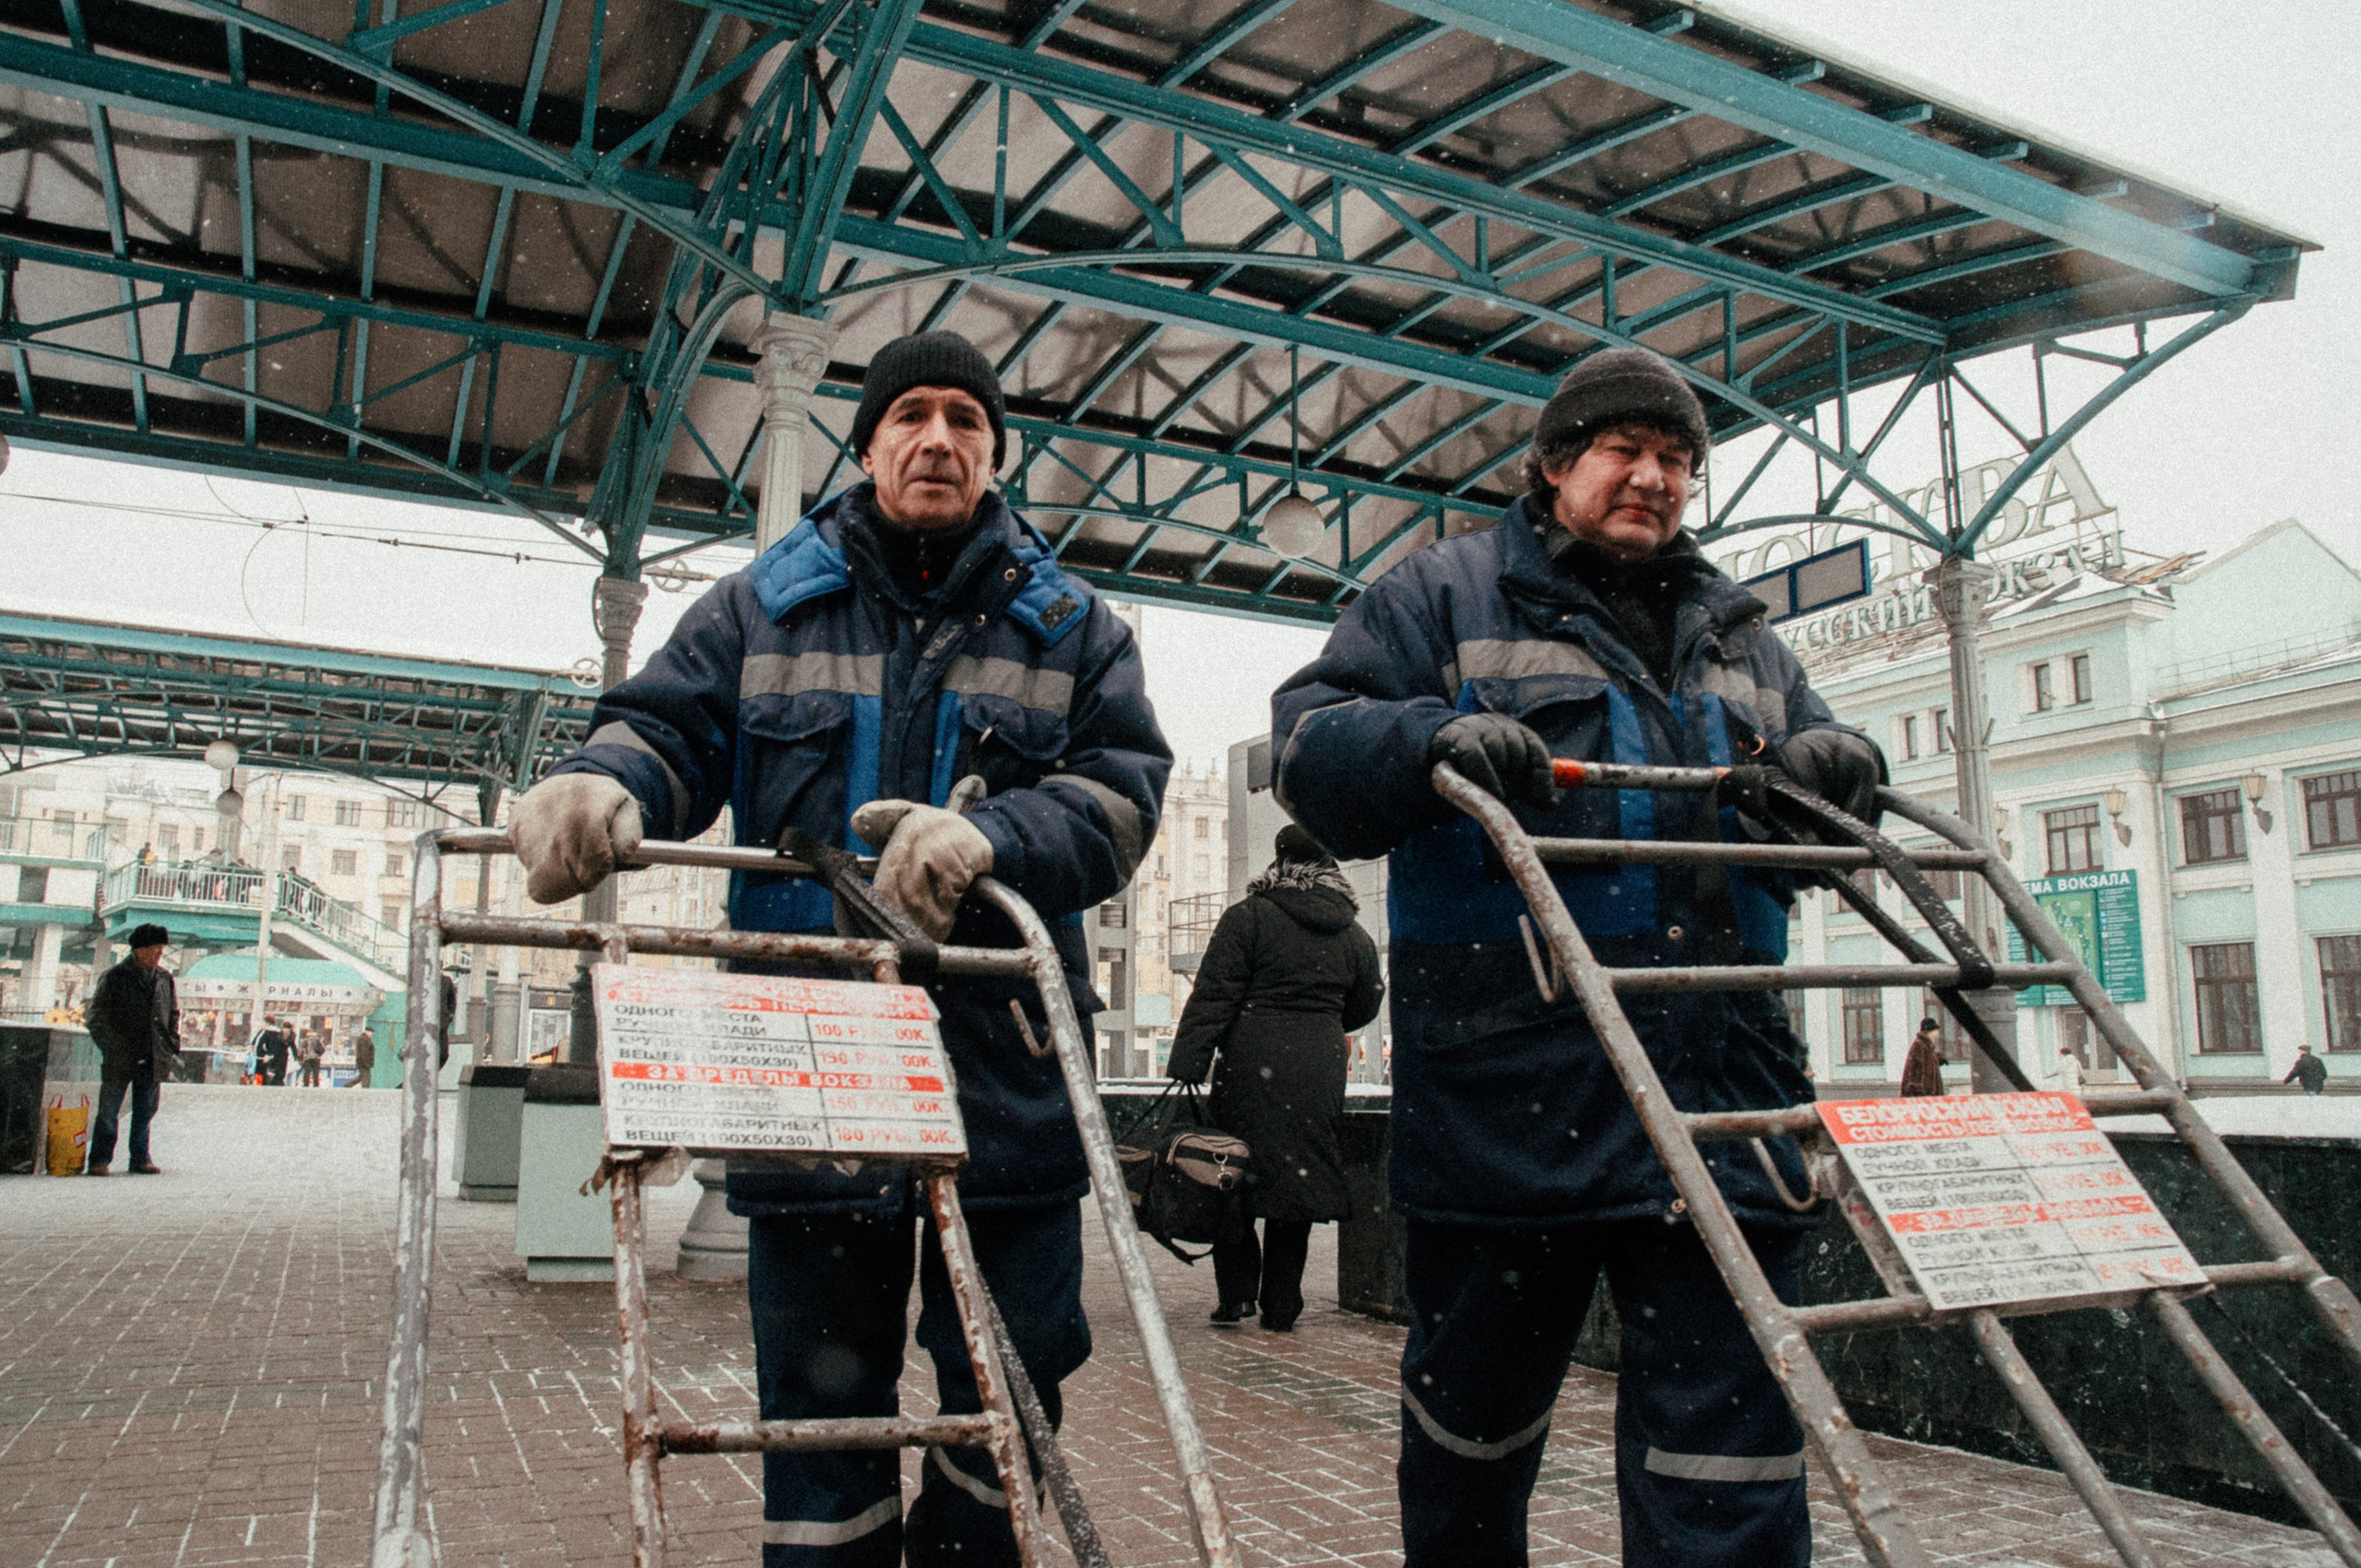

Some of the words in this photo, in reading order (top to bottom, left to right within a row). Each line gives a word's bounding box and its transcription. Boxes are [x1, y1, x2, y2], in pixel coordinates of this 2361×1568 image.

[1716, 441, 2117, 584] ОСКВА
[1781, 583, 1936, 651] УССКИЙ
[1986, 530, 2125, 604] КЗАЛ
[2058, 872, 2130, 892] ВОКЗАЛА
[238, 983, 333, 998] ЖРНАЛЫ
[613, 1004, 691, 1019] ОДНОГ
[813, 1022, 843, 1037] 100
[691, 1051, 800, 1069] (00Х50Х30)
[646, 1065, 678, 1078] ЗА
[701, 1131, 814, 1147] (00Х50Х30)
